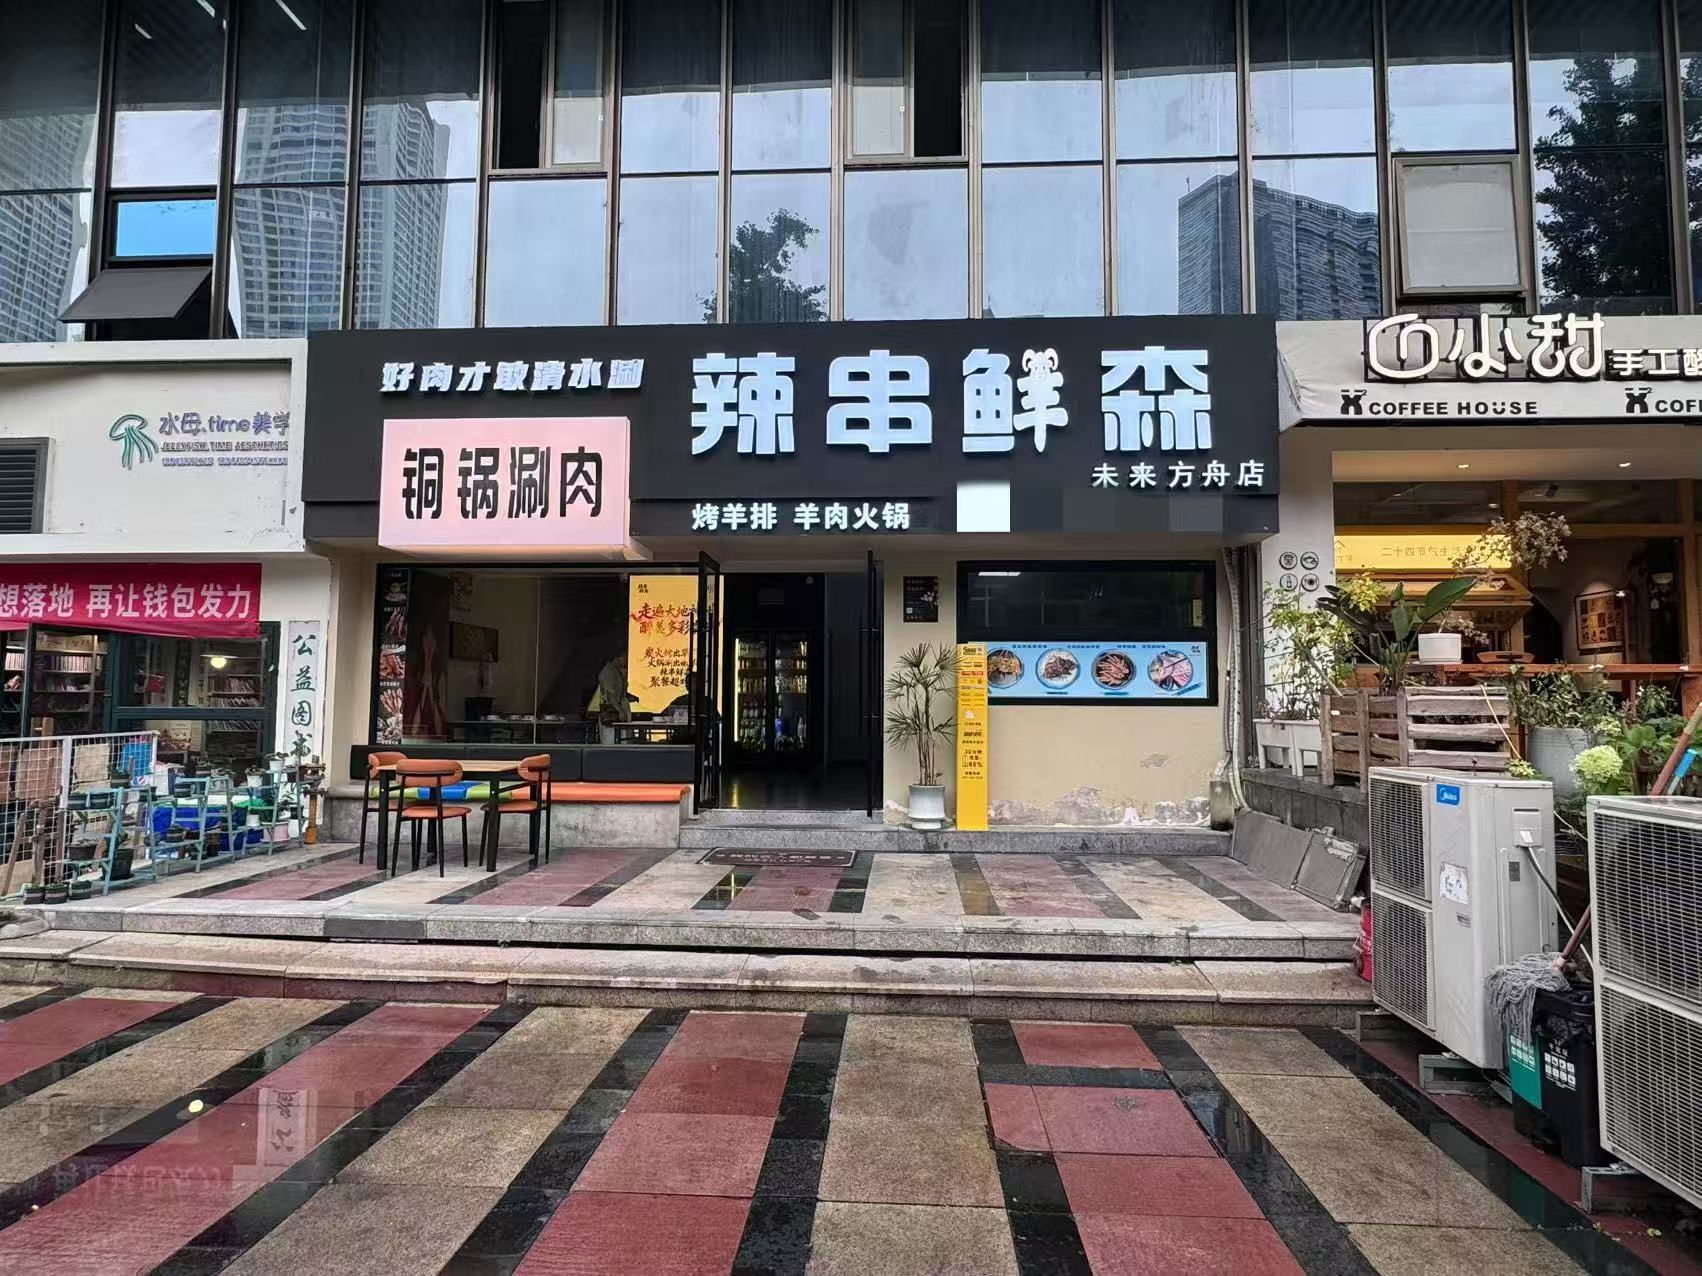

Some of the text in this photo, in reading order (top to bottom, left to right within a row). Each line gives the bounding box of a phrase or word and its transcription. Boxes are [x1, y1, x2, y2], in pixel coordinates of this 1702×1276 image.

[380, 358, 645, 392] 好肉才敢清水涮
[691, 346, 1212, 456] 辣串鲜森
[1368, 401, 1538, 416] COFFEE HOUSE
[402, 446, 603, 520] 铜锅涮肉
[1091, 459, 1265, 489] 未来方舟店
[692, 502, 911, 531] 烤羊排 羊肉火锅
[0, 583, 251, 619] 想落地 再让钱包发力
